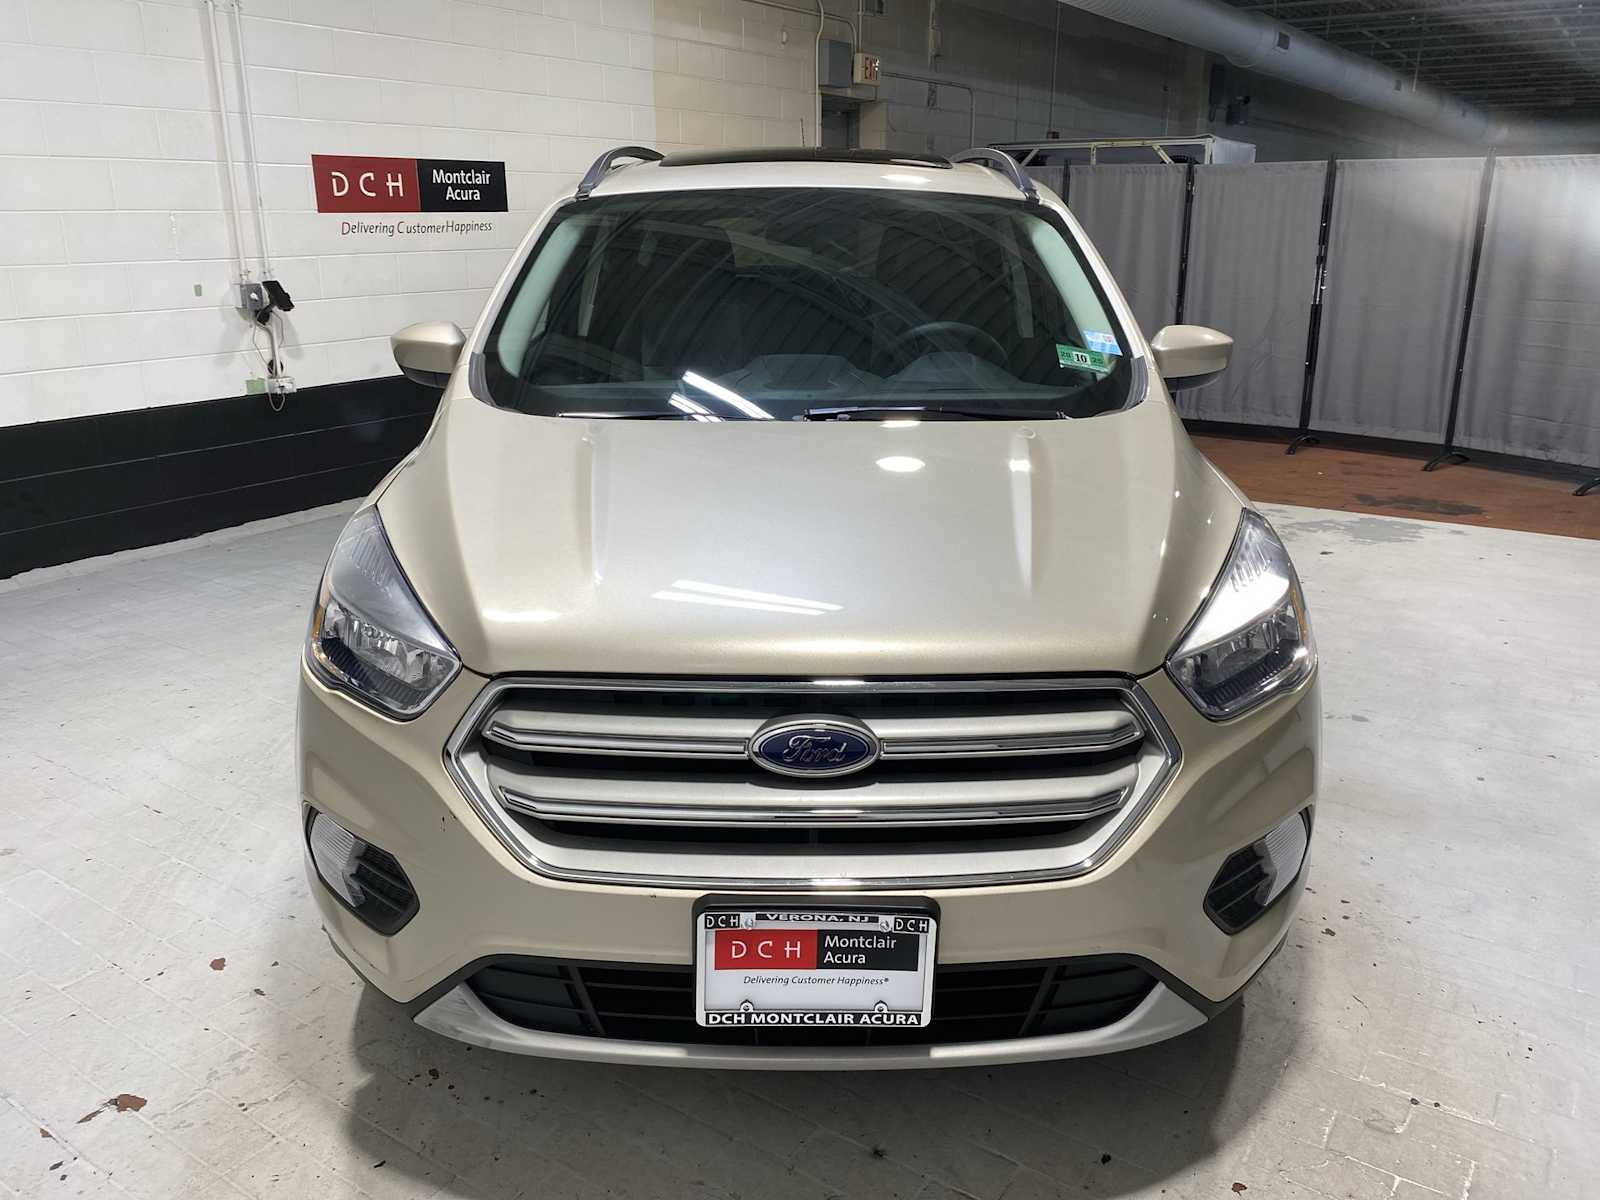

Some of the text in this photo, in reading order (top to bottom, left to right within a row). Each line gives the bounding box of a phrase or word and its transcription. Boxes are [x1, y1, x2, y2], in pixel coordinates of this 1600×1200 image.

[432, 169, 491, 185] Montclair
[331, 171, 404, 197] DCH
[445, 187, 480, 201] Acura
[341, 221, 395, 237] Delivering
[1075, 353, 1087, 363] 10
[783, 735, 847, 762] Ford
[706, 916, 739, 928] DCH
[766, 913, 870, 923] VERONA, NJ
[895, 919, 928, 932] DCH
[824, 935, 897, 949] Montclair
[731, 941, 801, 958] DCH
[823, 952, 866, 964] Acura
[743, 975, 789, 985] Delivering
[792, 976, 835, 985] Customer
[708, 1013, 919, 1025] DCH MONTCLAIR ACURA
